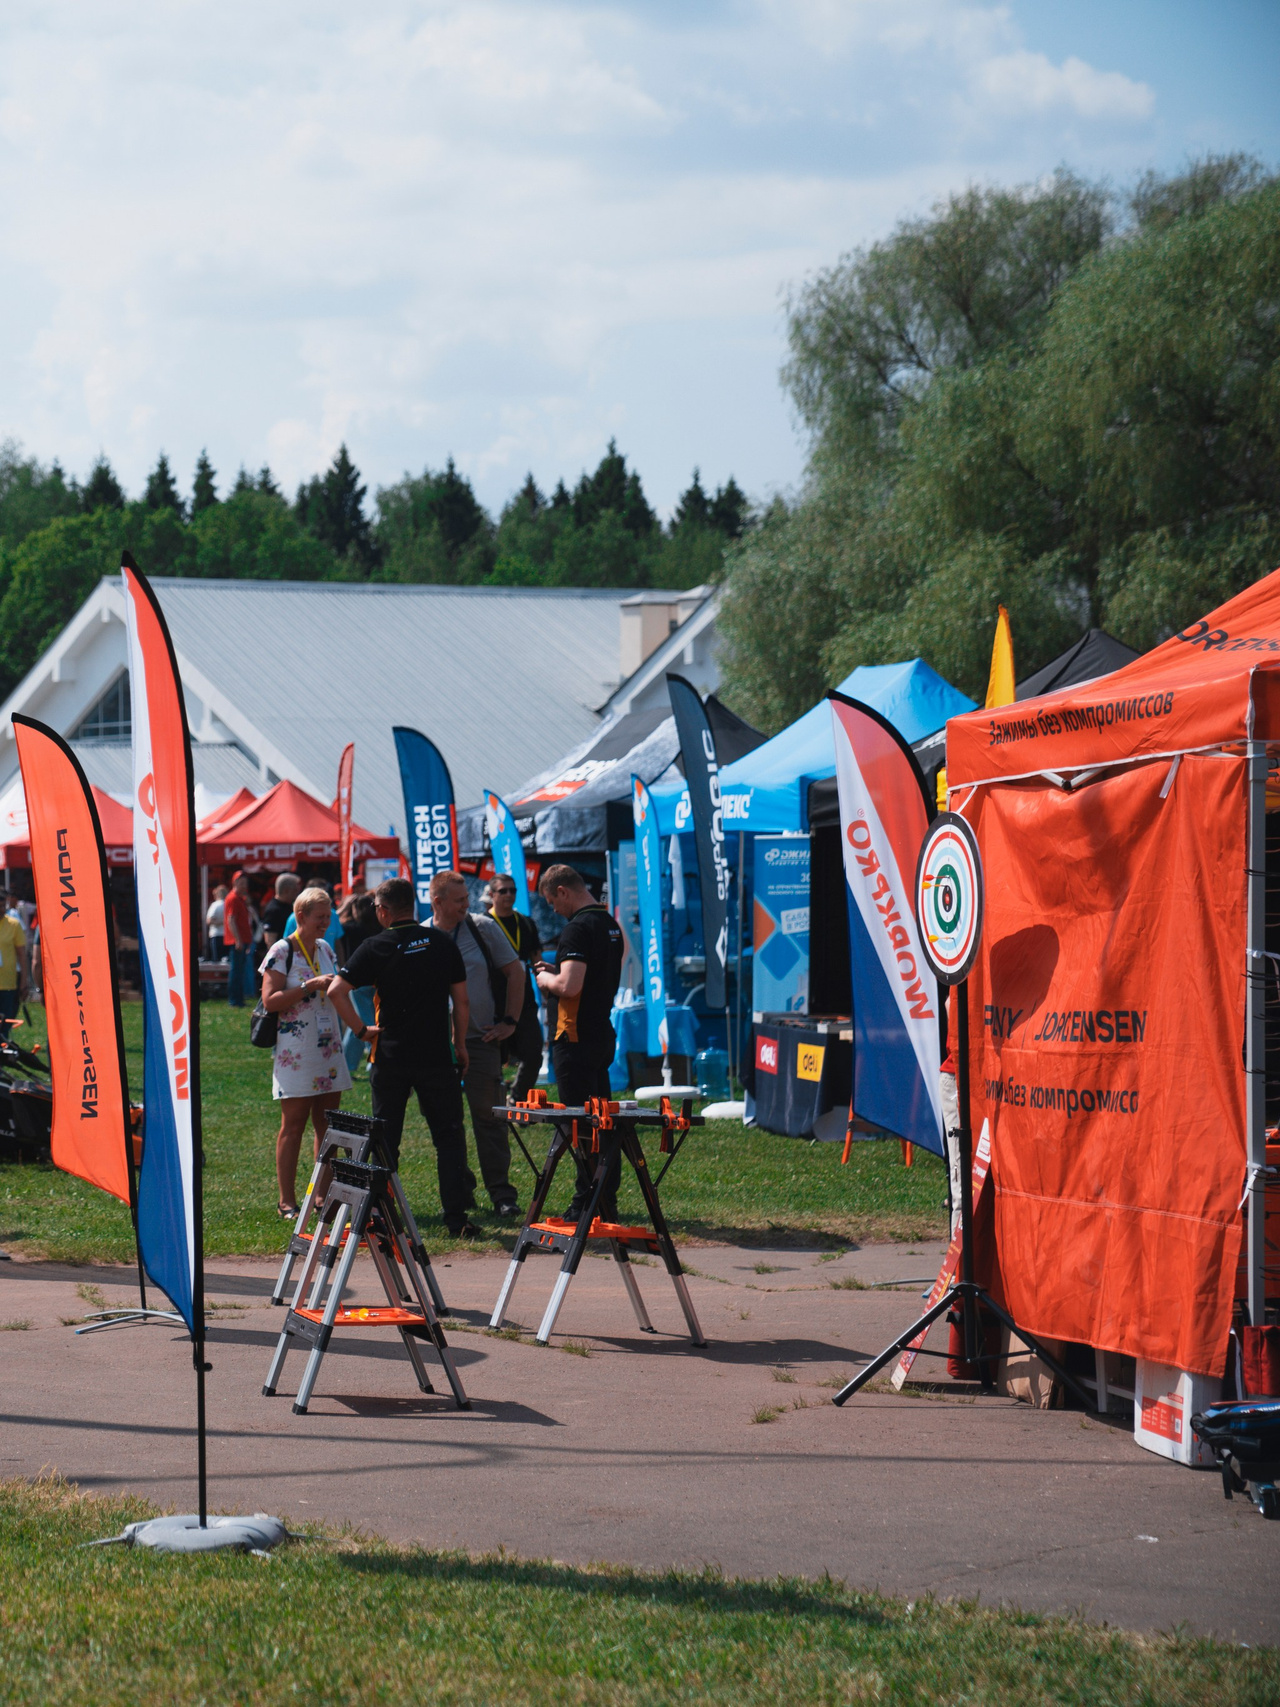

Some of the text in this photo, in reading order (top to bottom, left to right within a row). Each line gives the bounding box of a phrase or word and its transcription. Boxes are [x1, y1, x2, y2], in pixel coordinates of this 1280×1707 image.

[989, 692, 1175, 746] Зажимы без компромиссов
[431, 804, 451, 872] rden
[760, 1043, 776, 1067] deli
[803, 1053, 818, 1073] deli
[1007, 1077, 1026, 1107] без
